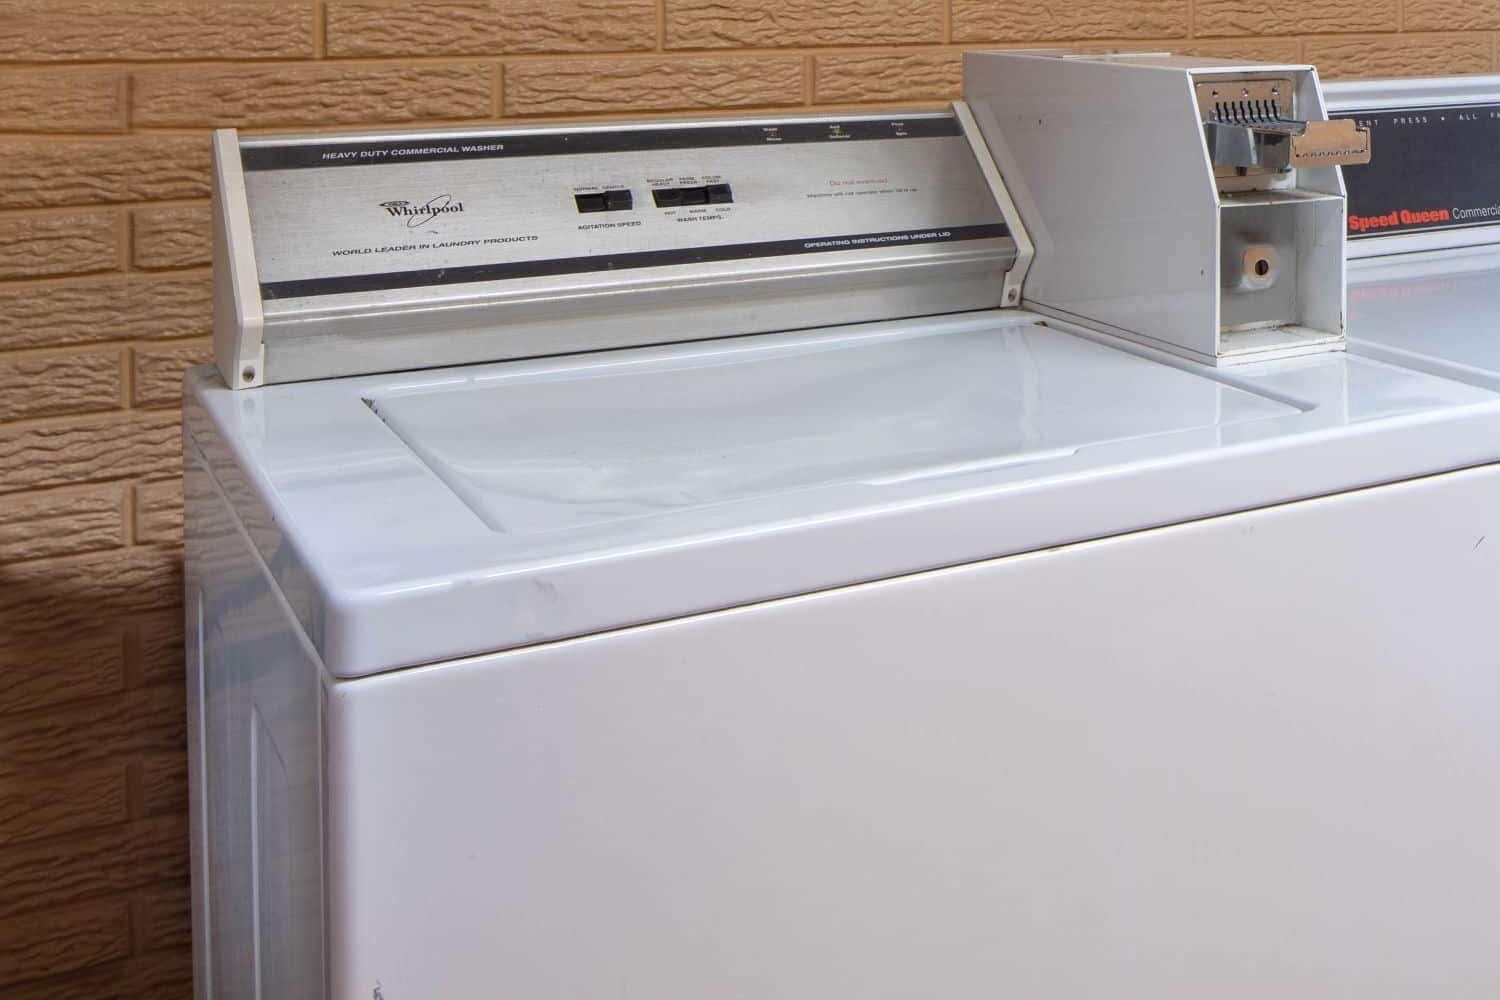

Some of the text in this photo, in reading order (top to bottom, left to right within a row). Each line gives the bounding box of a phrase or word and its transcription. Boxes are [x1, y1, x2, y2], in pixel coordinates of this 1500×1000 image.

[1393, 116, 1428, 125] PRESS
[1459, 113, 1478, 121] ALL
[322, 144, 504, 160] HEAVY DUTY COMMERCIAL WASHER
[386, 201, 464, 217] Whirlpool
[1349, 210, 1399, 231] Speed
[1400, 208, 1450, 225] Queen
[332, 247, 373, 257] WORLD
[375, 243, 417, 253] LEADER
[432, 239, 481, 249] LAUNDRY
[483, 235, 538, 245] PRODUCTS
[804, 239, 850, 248] OPERATING
[851, 235, 909, 245] INSTRUCTIONS
[910, 232, 937, 240] UNDER
